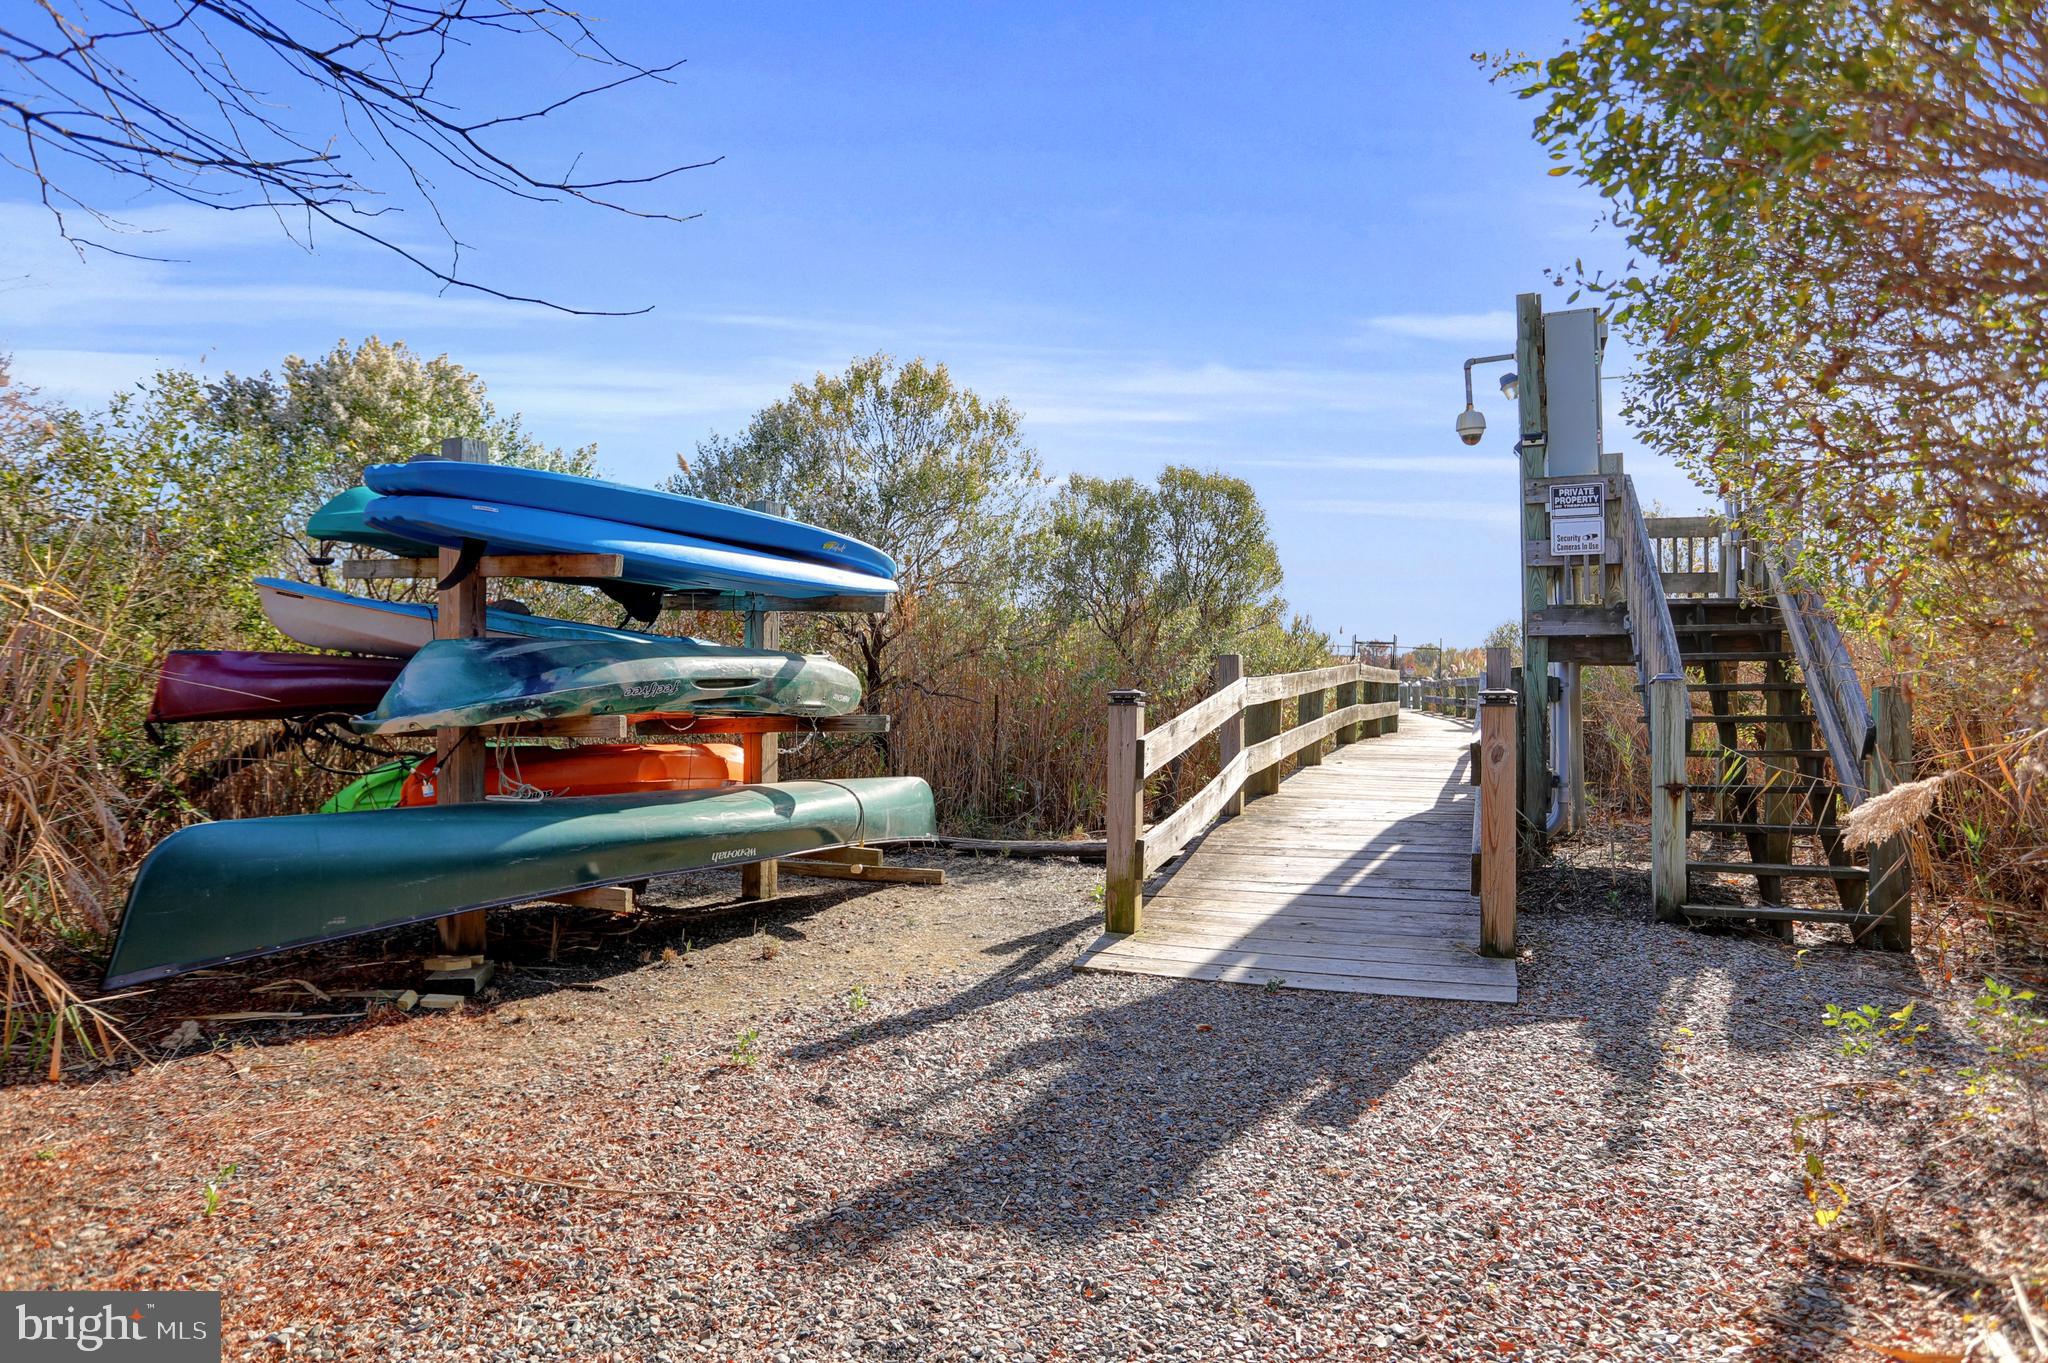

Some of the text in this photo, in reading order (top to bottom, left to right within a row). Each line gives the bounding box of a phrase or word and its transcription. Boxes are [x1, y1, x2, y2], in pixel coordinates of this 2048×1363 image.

[1559, 487, 1594, 496] PRIVATE
[1554, 495, 1599, 504] PROPERTY
[1556, 534, 1581, 542] Security
[1556, 542, 1599, 551] Cameras In Use
